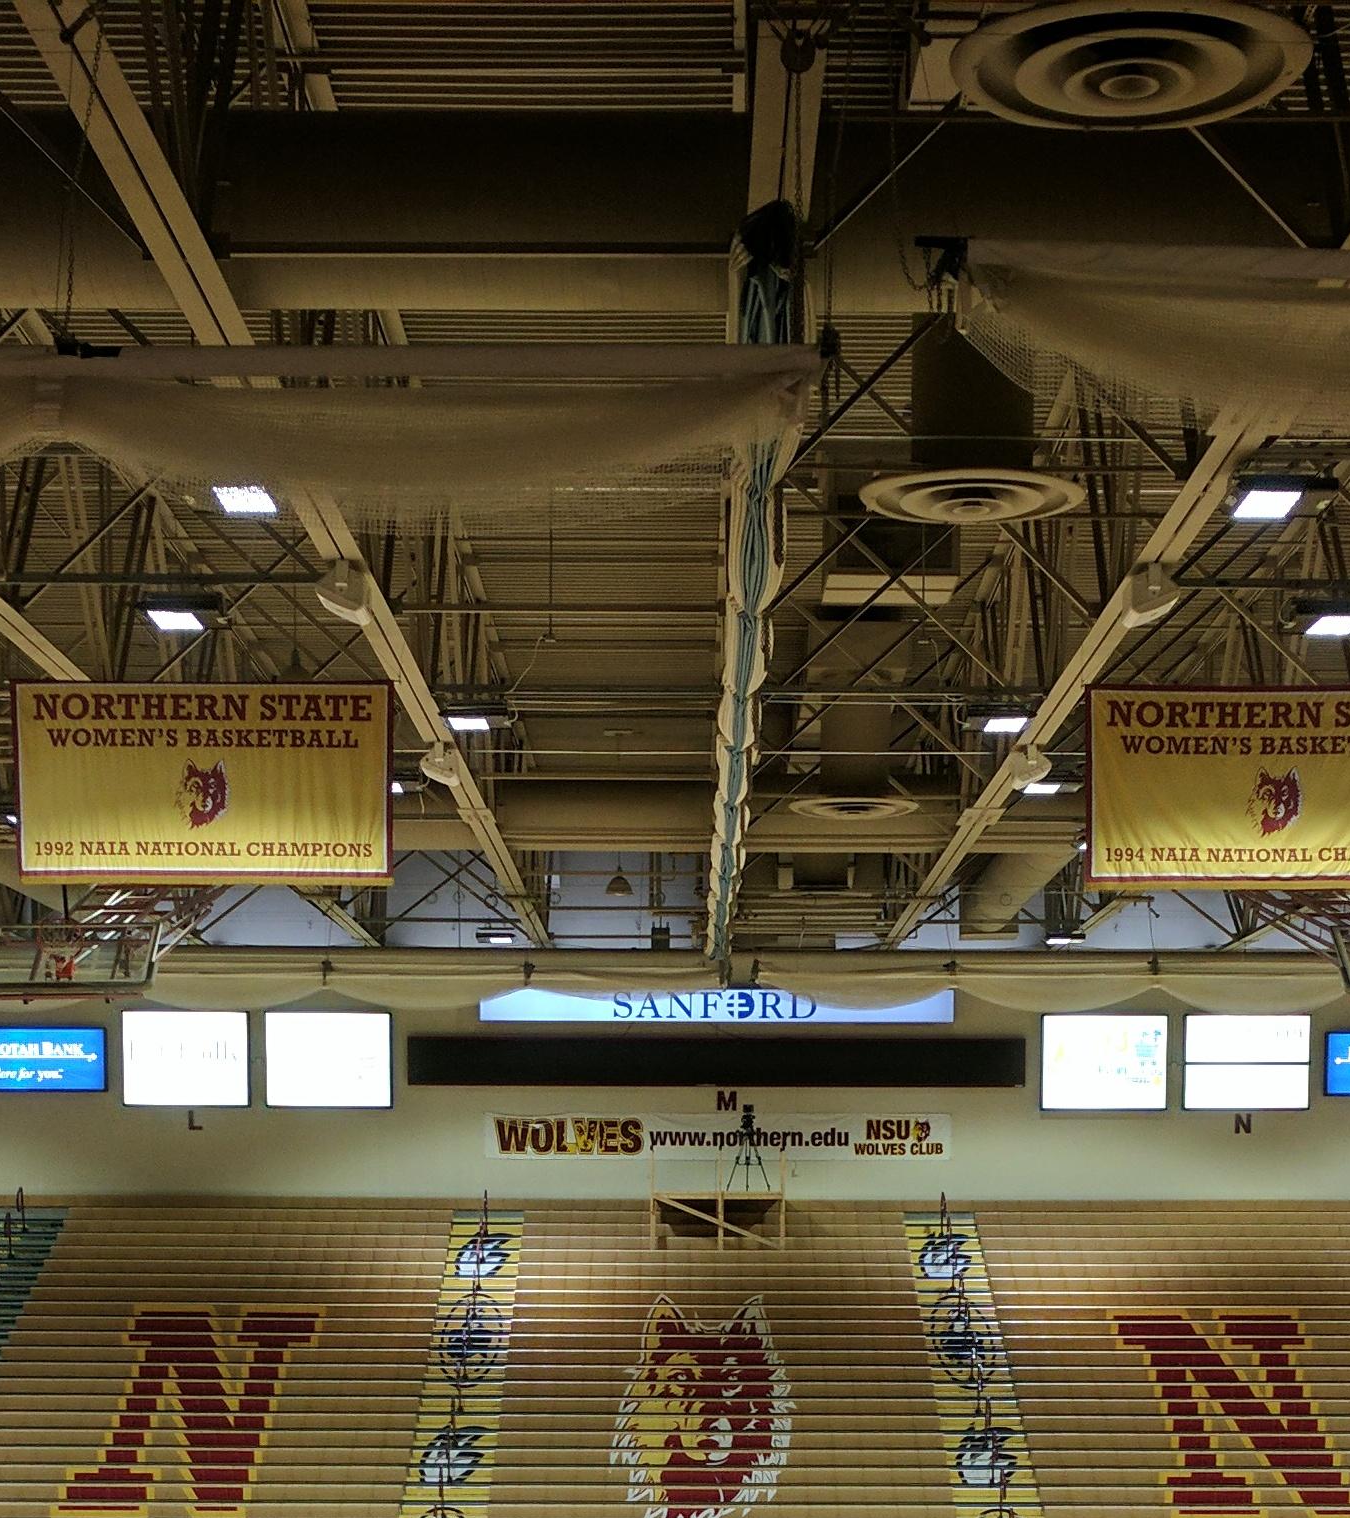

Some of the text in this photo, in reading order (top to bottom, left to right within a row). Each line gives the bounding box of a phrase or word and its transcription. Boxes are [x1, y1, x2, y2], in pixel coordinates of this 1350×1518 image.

[33, 693, 372, 722] NORTHERN STATE
[1106, 699, 1325, 728] NORTHERN
[48, 728, 360, 749] WOMEN'S BASKETBALL
[1121, 735, 1251, 755] WOMEN'S
[35, 841, 373, 859] 1992 NAIA NATIONAL CHAMPIONS
[1103, 845, 1145, 863] 1994
[1149, 845, 1199, 863] NAIA
[1203, 846, 1314, 863] NATIONAL
[612, 990, 818, 1019] SANFORD
[42, 1041, 85, 1056] BANK
[17, 1066, 35, 1081] for
[716, 1090, 738, 1112] M
[188, 1110, 203, 1131] L
[865, 1119, 911, 1140] NSU
[1234, 1113, 1252, 1135] N
[496, 1116, 644, 1157] WOLVES
[854, 1142, 944, 1156] WOLVES CLUB
